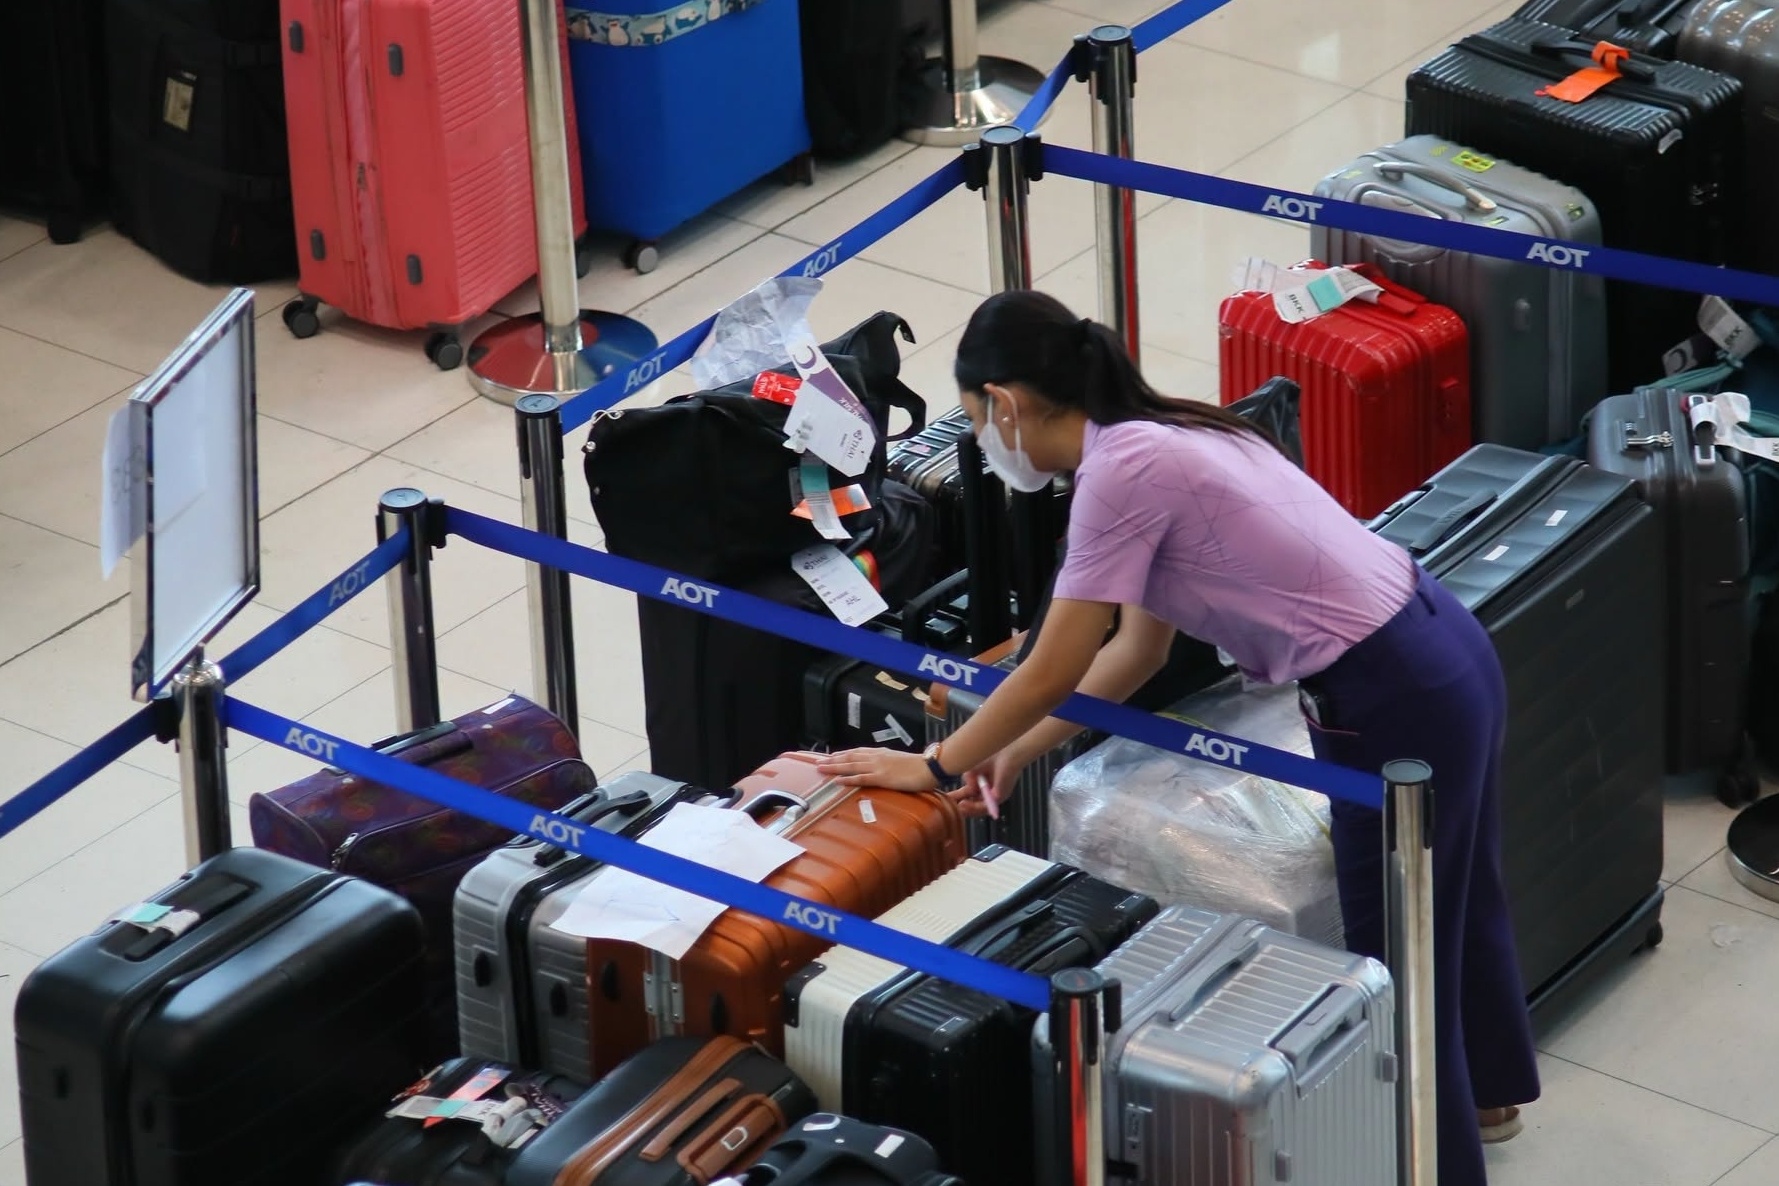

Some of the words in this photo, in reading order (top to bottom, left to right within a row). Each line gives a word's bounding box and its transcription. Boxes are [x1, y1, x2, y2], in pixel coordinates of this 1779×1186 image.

[1262, 195, 1323, 221] AOT
[803, 242, 842, 277] AOT
[1526, 243, 1590, 268] AOT
[625, 351, 668, 393] AOT
[329, 561, 371, 607] AOT
[661, 577, 719, 608] AOT
[918, 654, 979, 687] AOT
[285, 727, 339, 762] AOT
[1185, 734, 1250, 766] AOT
[530, 814, 585, 848] AOT
[784, 901, 842, 934] AOT
